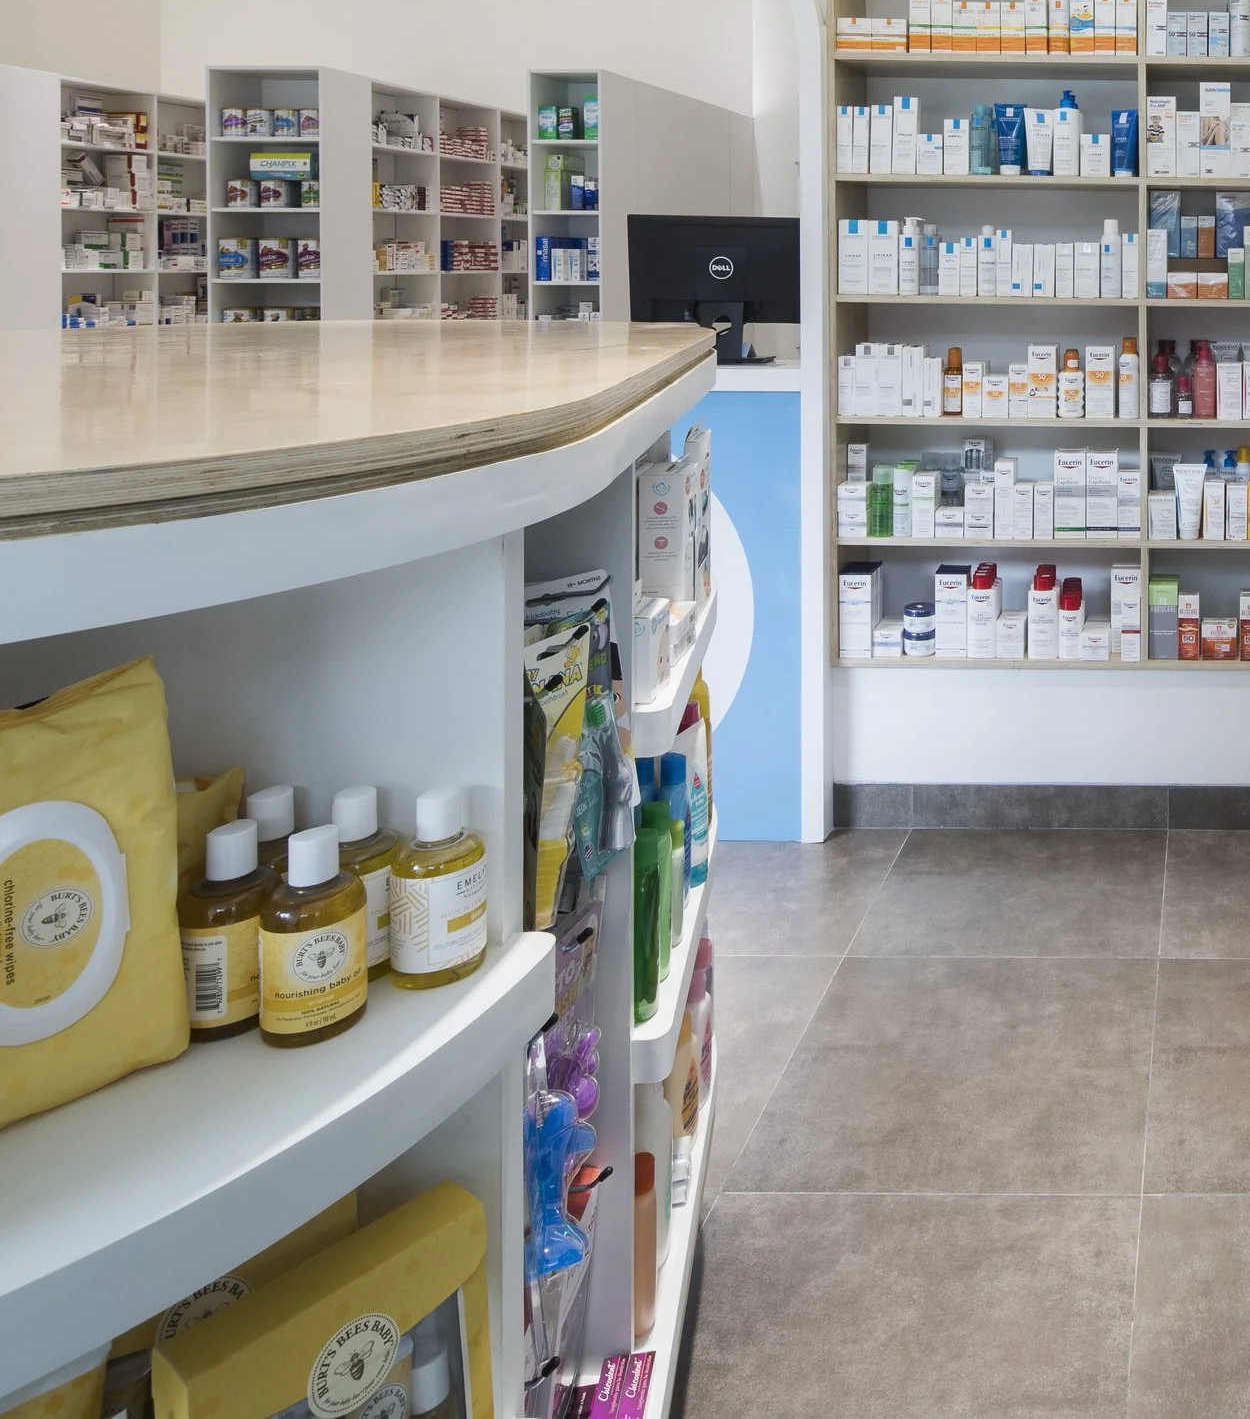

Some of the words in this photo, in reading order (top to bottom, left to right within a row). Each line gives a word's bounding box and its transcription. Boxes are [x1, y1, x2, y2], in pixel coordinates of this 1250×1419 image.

[260, 160, 296, 168] CHAMPIX
[712, 263, 731, 272] DELL
[1058, 458, 1082, 467] Eucerin
[1089, 458, 1114, 467] Eucerin
[577, 575, 602, 586] MONTHS
[1114, 574, 1138, 582] Eucerin
[843, 579, 867, 588] Eucerin
[939, 579, 963, 587] Eucerin
[296, 941, 313, 968] BURT'S
[314, 934, 335, 944] BEES
[334, 936, 346, 955] BABY
[4, 952, 16, 986] wipes
[275, 986, 326, 1000] nourishing
[329, 974, 351, 990] baby
[353, 967, 362, 978] oil
[317, 1348, 337, 1399] BURT'S
[336, 1320, 370, 1348] BEES
[371, 1320, 394, 1346] BABY
